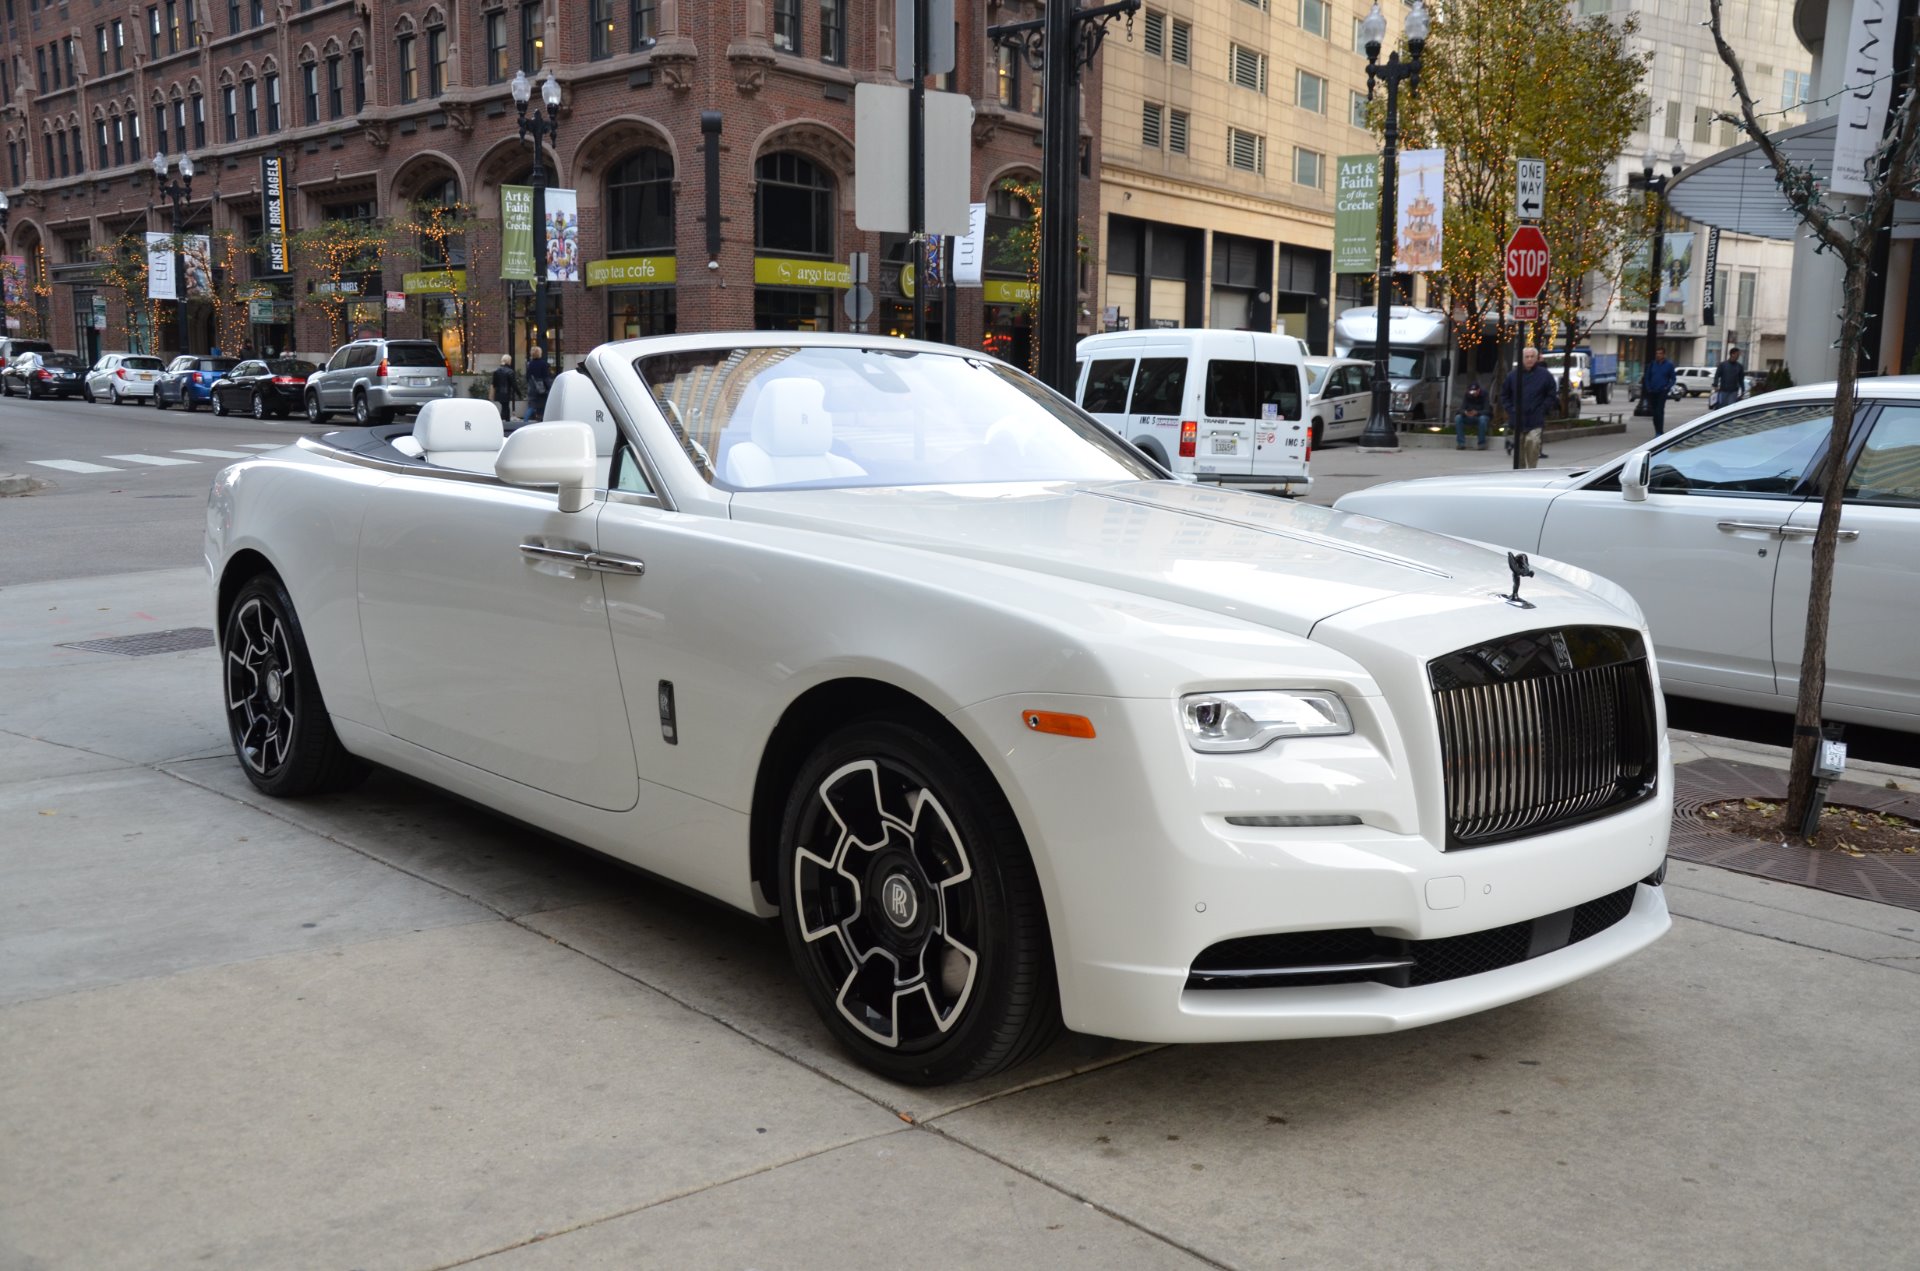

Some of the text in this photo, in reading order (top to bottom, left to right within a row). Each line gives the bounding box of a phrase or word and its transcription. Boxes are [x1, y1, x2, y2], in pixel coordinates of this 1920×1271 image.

[1341, 163, 1375, 175] Art &
[1521, 164, 1542, 179] ONE
[267, 159, 280, 196] BAGELS
[1341, 175, 1373, 189] Faith
[1520, 181, 1542, 195] WAY
[505, 191, 530, 202] Art &
[1346, 190, 1367, 200] of the
[506, 202, 530, 213] Faith
[1338, 199, 1375, 211] Creche
[270, 199, 281, 225] BROS.
[505, 221, 531, 230] Creche
[1342, 247, 1367, 255] LUMA
[611, 265, 624, 278] tea
[627, 259, 655, 277] café
[1508, 249, 1547, 277] STOP
[797, 268, 822, 285] argo
[823, 266, 836, 281] tea
[1703, 284, 1713, 309] rack
[1139, 416, 1156, 424] IMC 5
[1285, 438, 1305, 447] IMC 5
